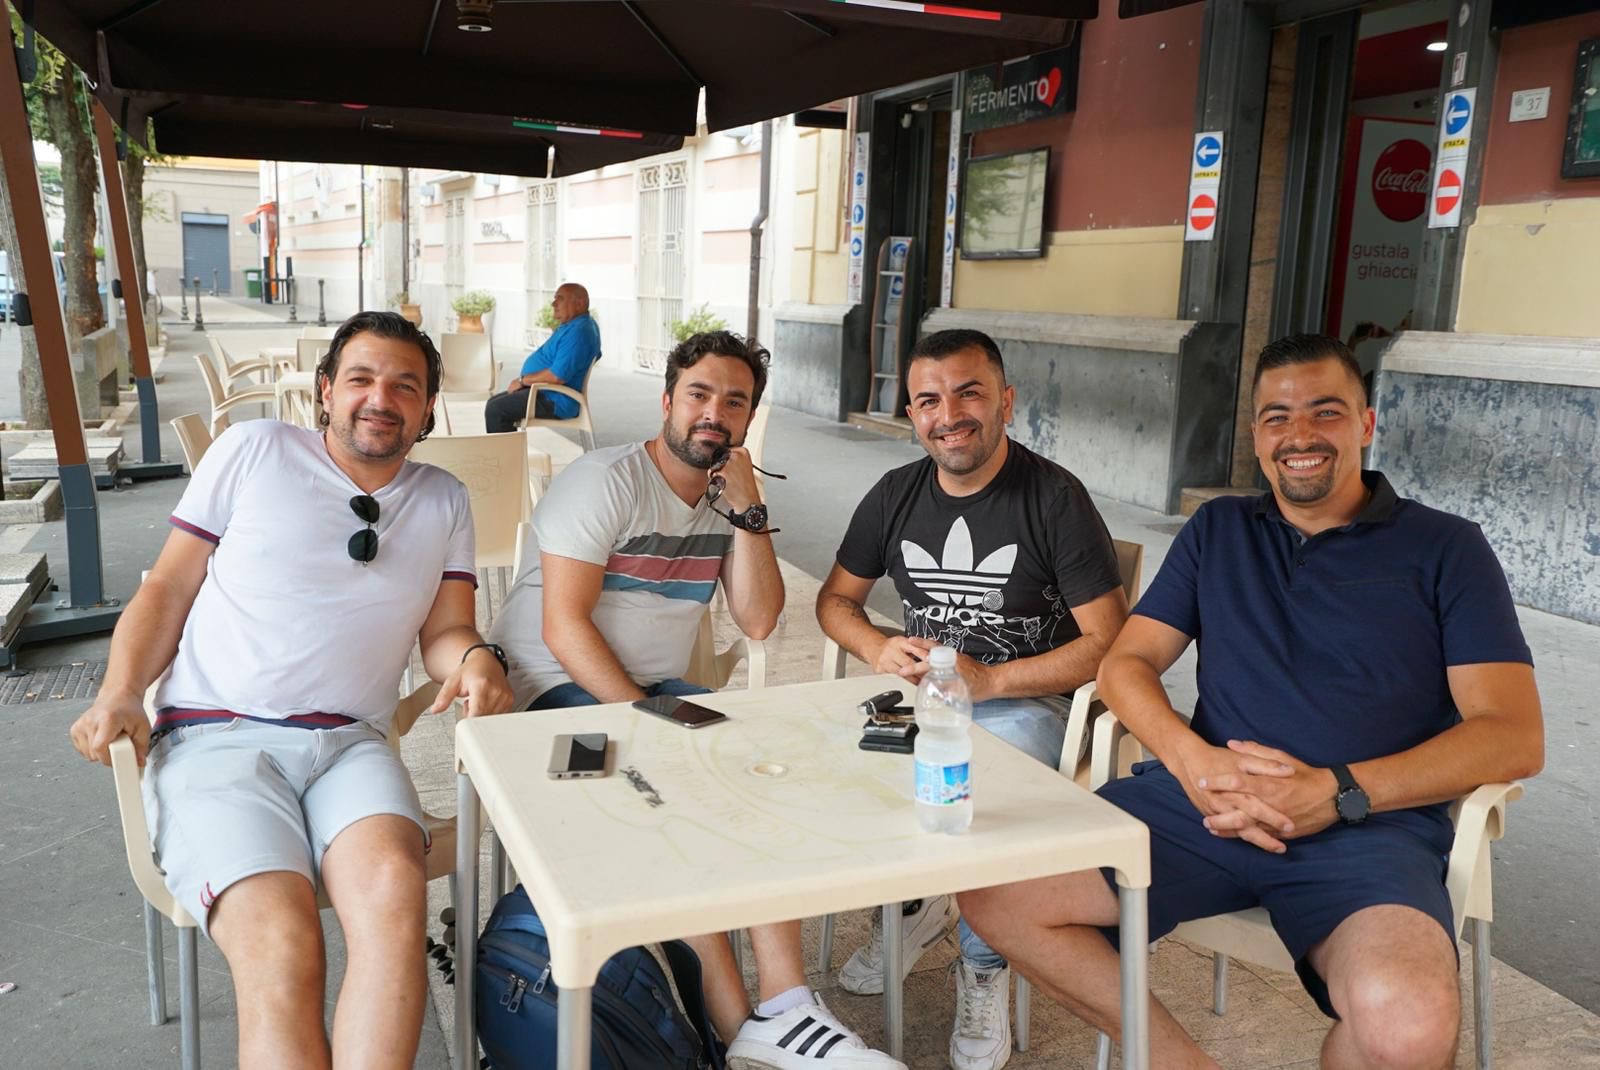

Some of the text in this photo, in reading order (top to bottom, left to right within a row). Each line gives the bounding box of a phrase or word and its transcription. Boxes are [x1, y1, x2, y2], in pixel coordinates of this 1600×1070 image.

[969, 77, 1049, 114] FERMENTO
[1527, 97, 1544, 111] 37
[1352, 243, 1409, 259] gustala
